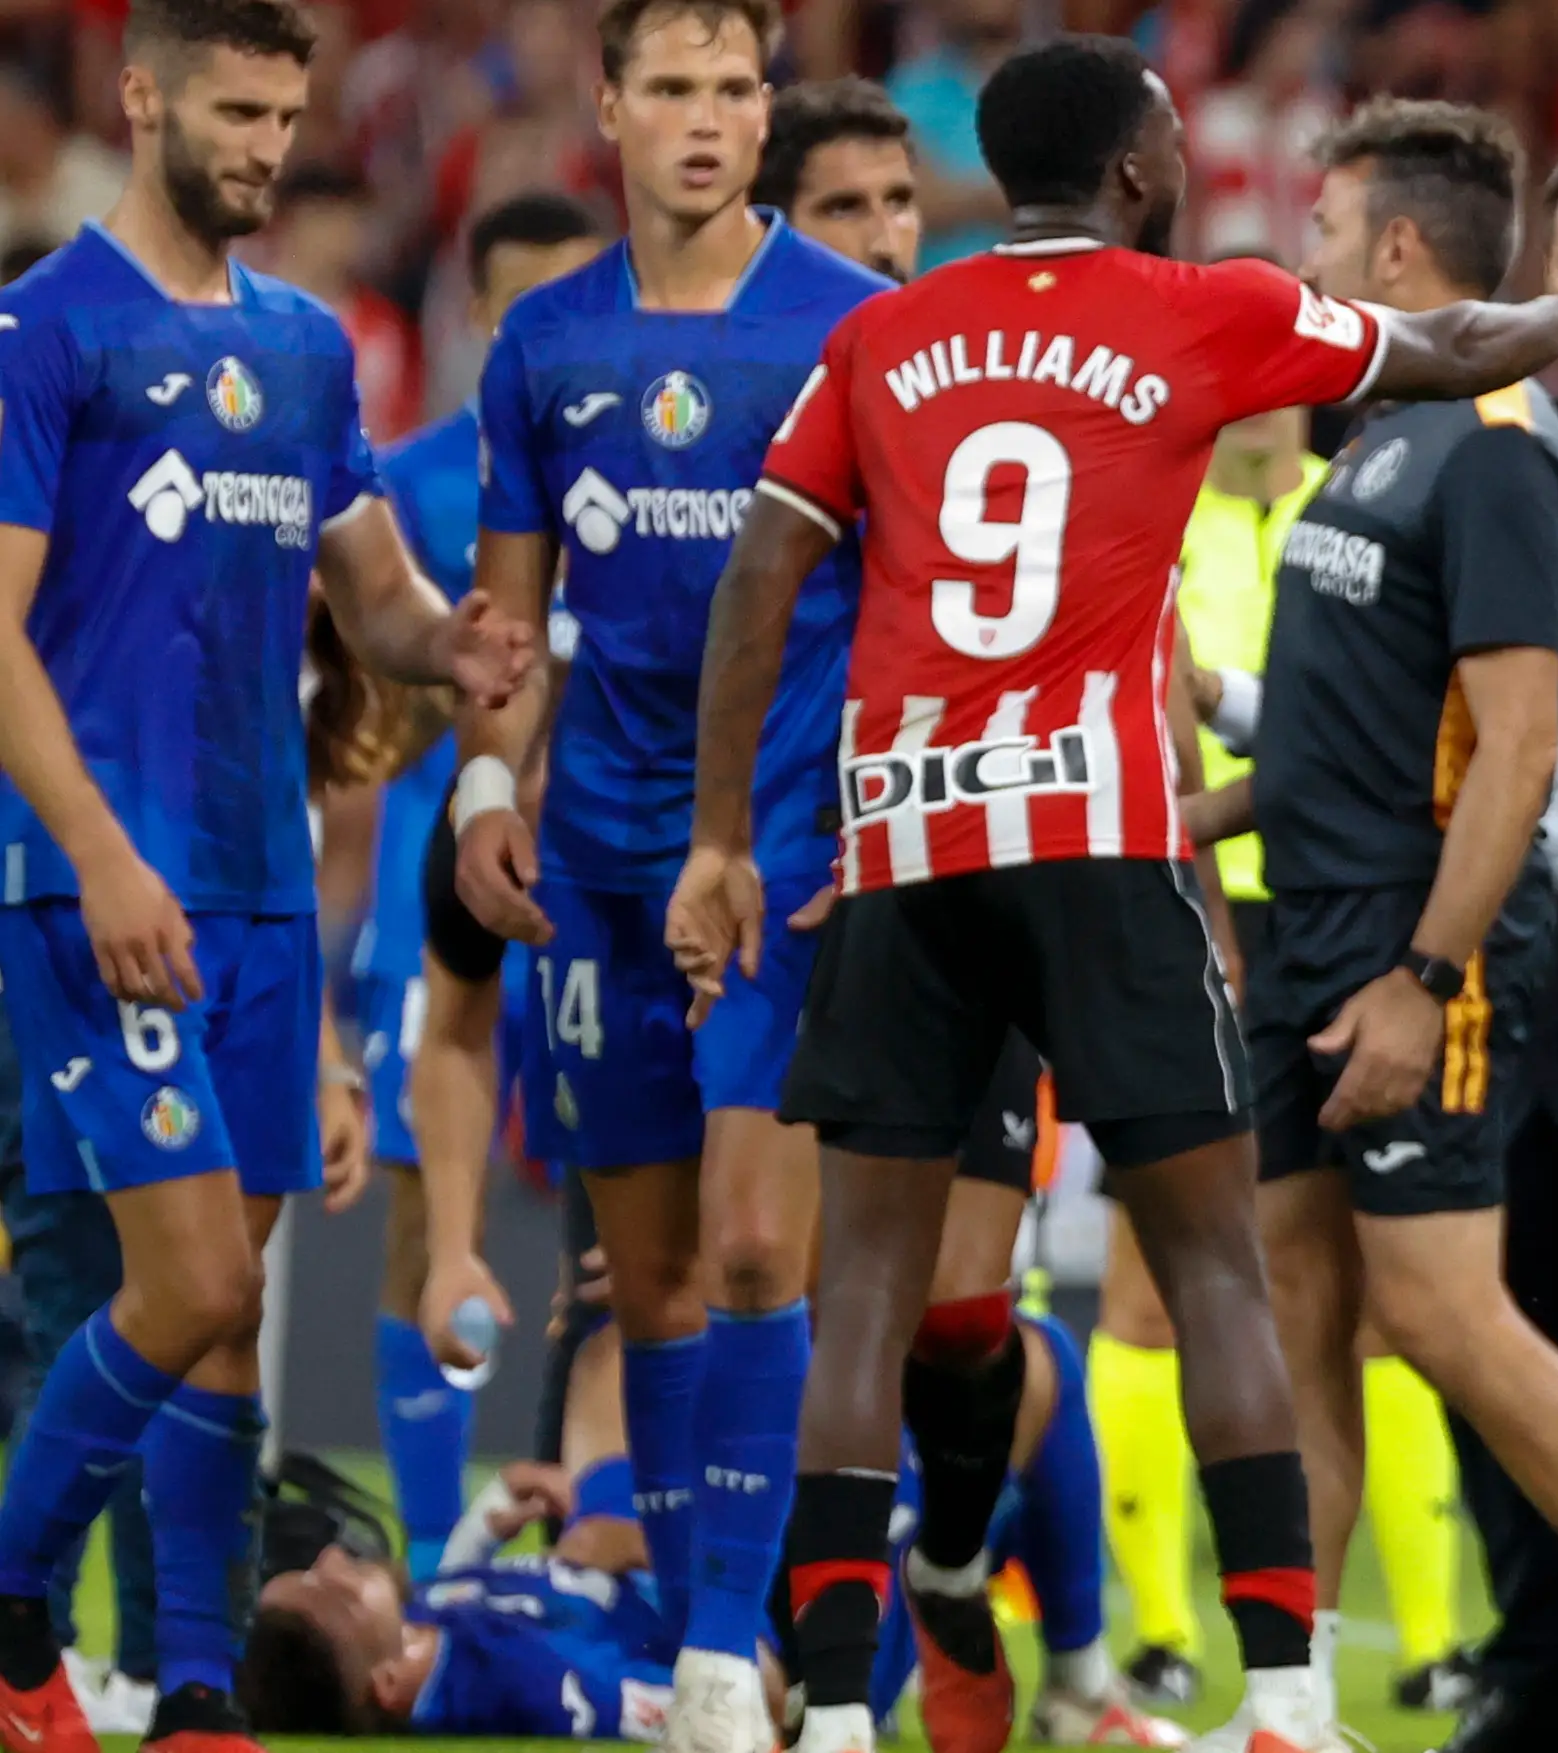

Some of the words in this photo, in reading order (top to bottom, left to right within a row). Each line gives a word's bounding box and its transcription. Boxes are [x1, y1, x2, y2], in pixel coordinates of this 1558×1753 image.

[884, 330, 1170, 426] WILLIAMS
[930, 419, 1072, 660] 9
[838, 726, 1097, 829] DIGI
[116, 998, 180, 1073] 6
[536, 956, 604, 1060] 14
